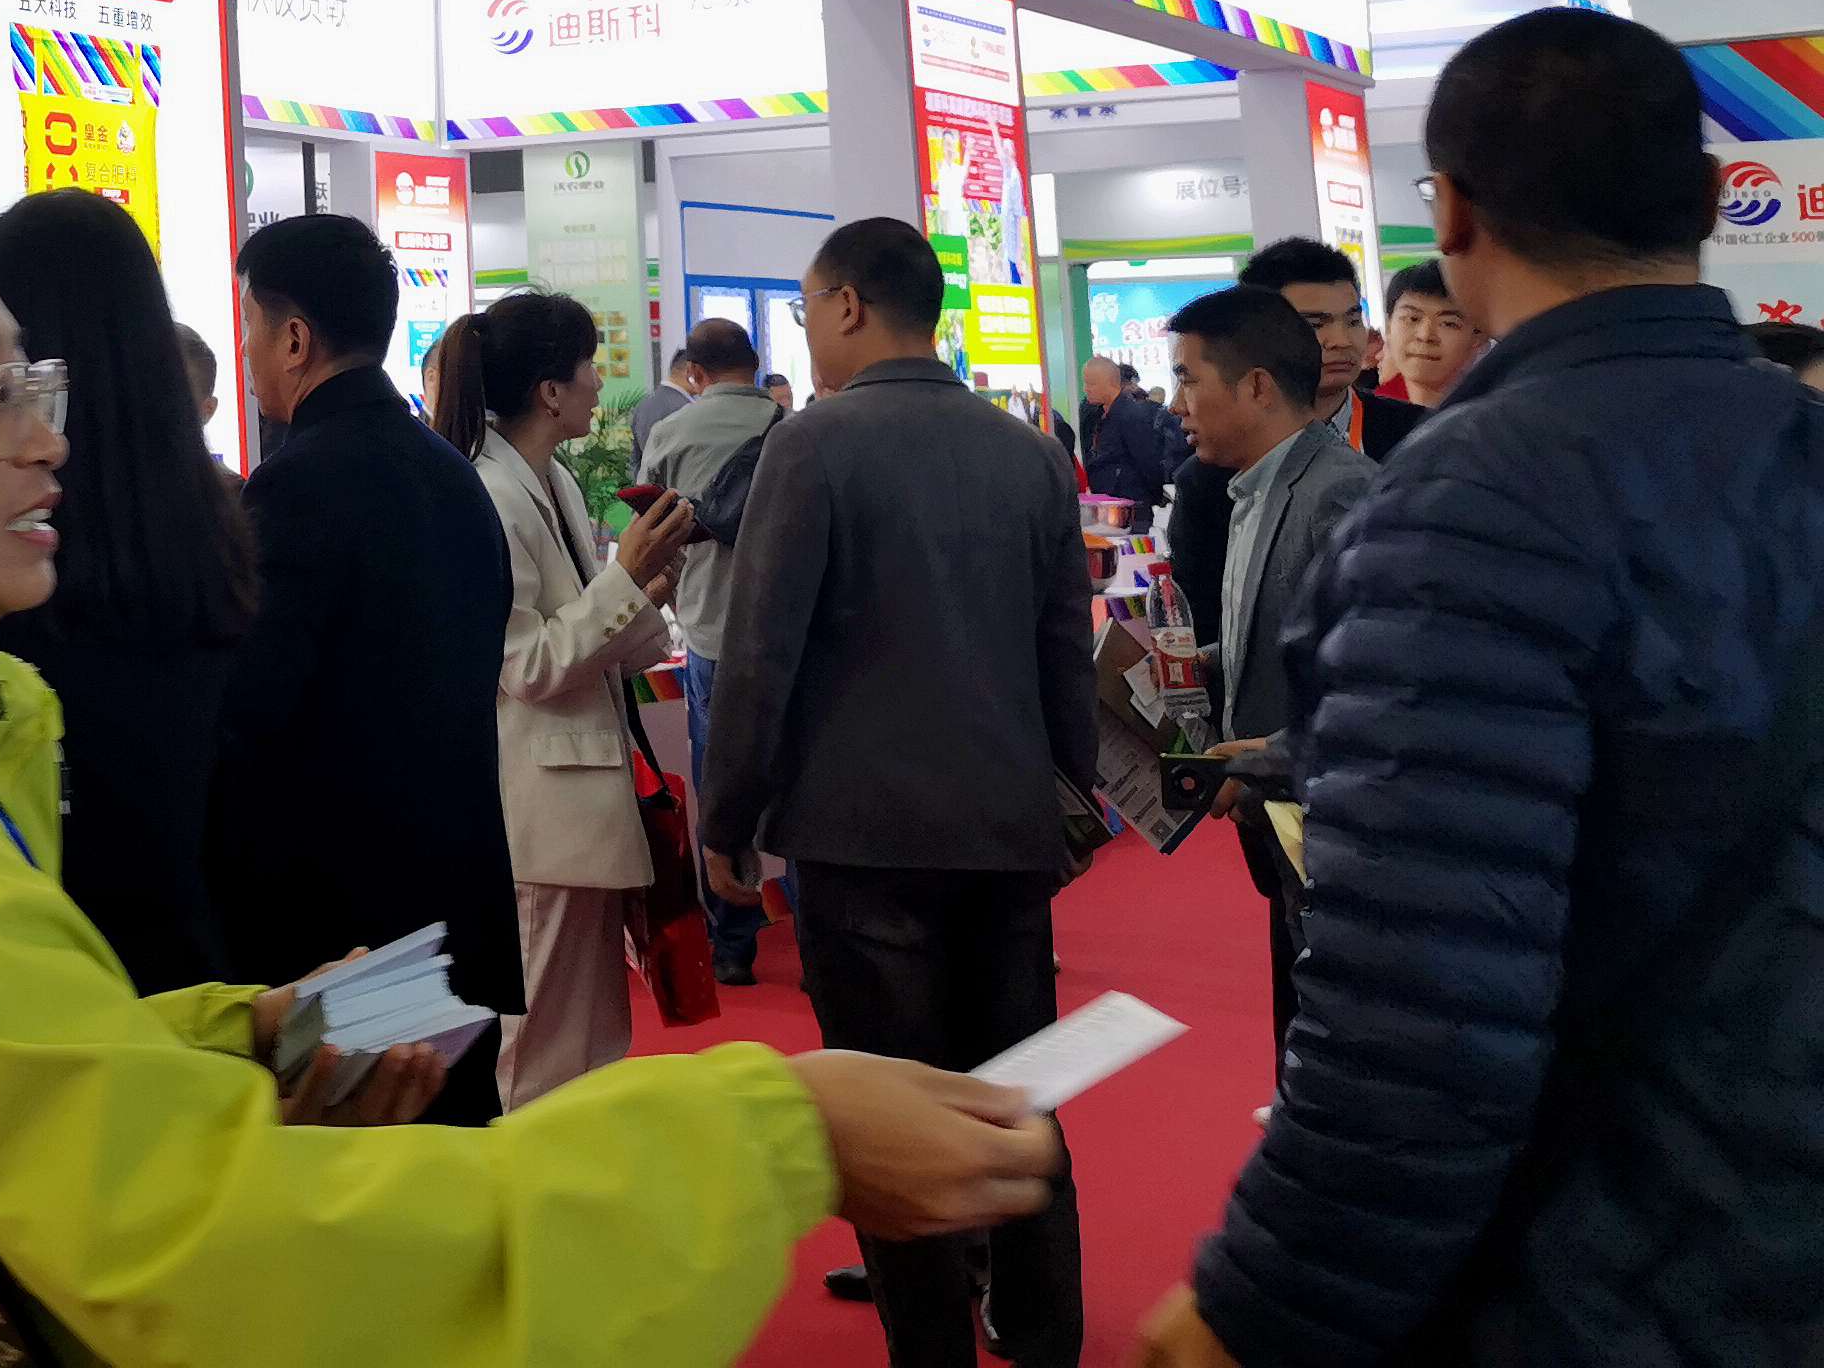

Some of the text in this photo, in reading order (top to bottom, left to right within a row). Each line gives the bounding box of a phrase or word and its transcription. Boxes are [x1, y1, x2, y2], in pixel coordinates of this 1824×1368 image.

[98, 5, 154, 32] 五重增效
[547, 2, 662, 48] 迪斯科
